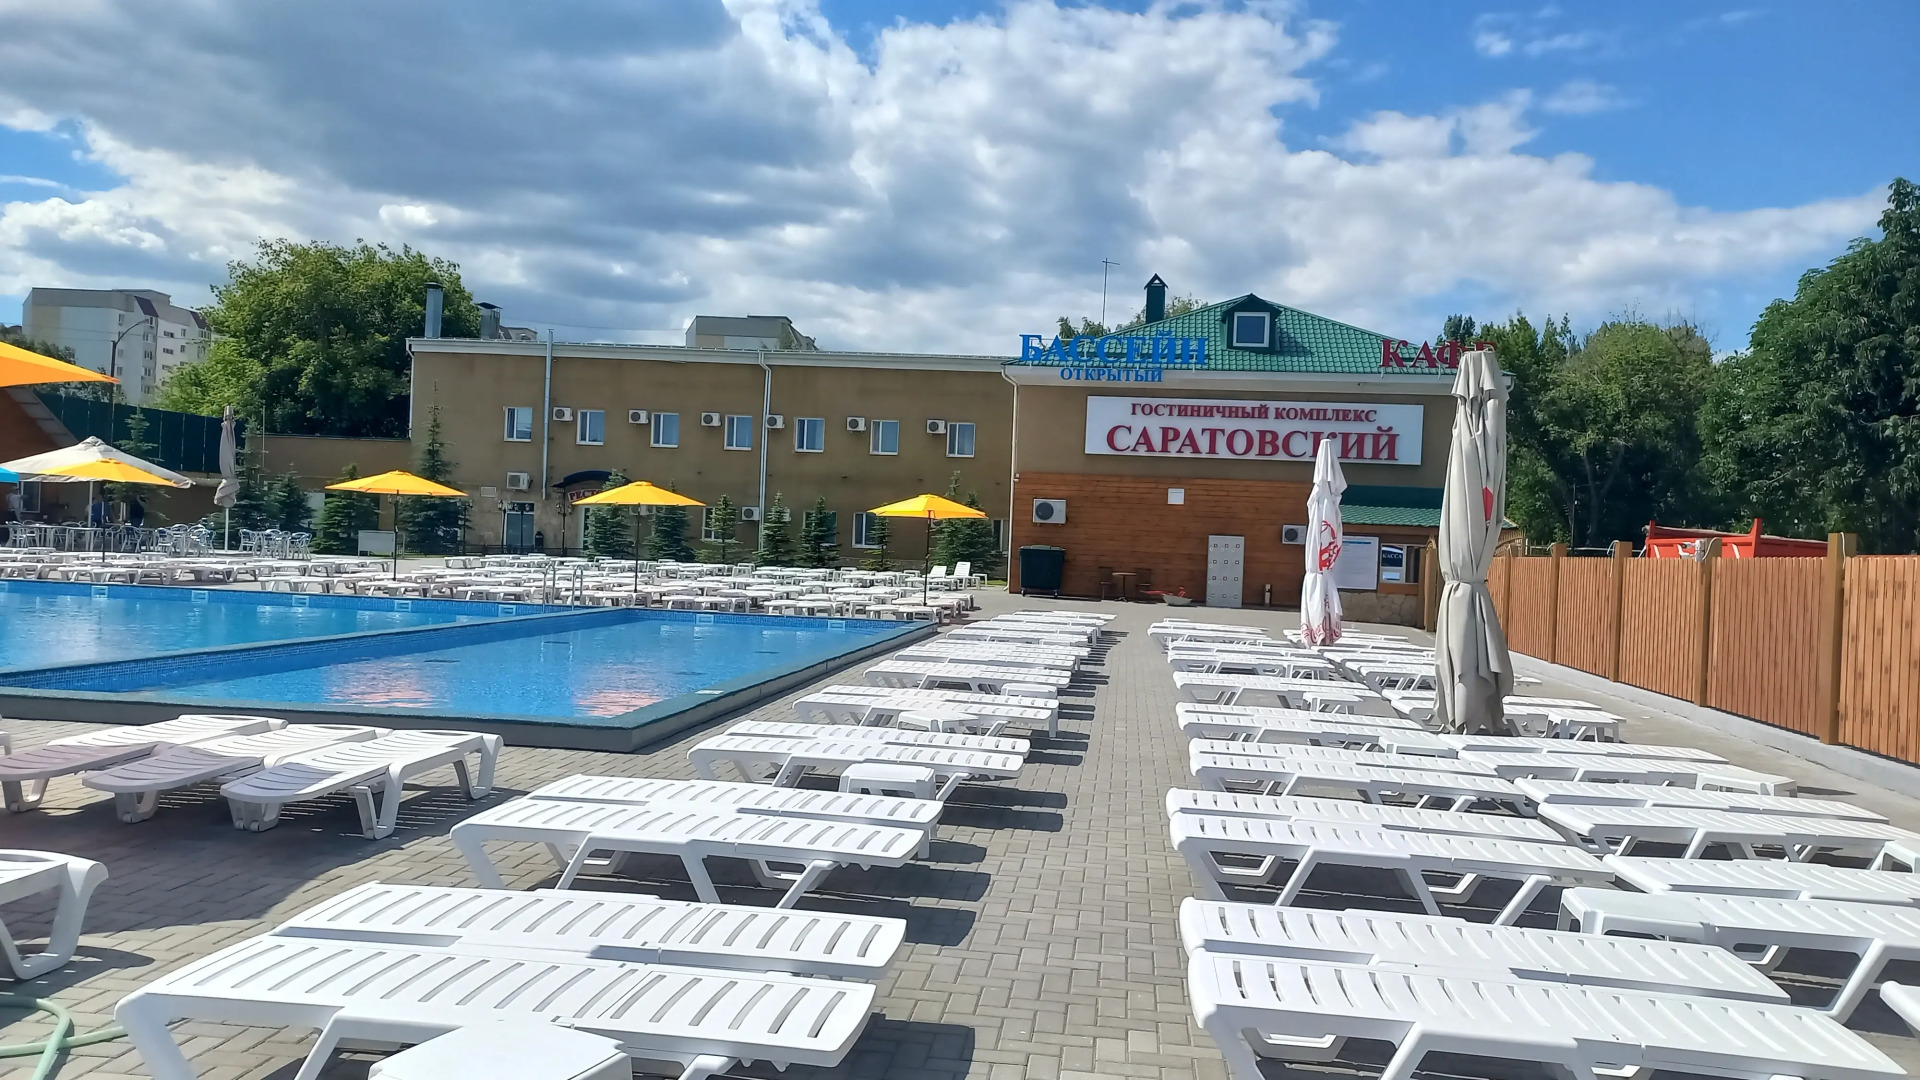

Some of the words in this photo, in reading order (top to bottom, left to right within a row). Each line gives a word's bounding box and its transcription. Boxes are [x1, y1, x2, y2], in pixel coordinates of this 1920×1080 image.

[1019, 330, 1208, 364] БАССЕЙН
[1060, 367, 1163, 382] ОТКРЫТЫЙ
[1131, 403, 1269, 419] ГОСТИНИЧНЫЙ
[1274, 407, 1377, 422] КОМПЛЕКС
